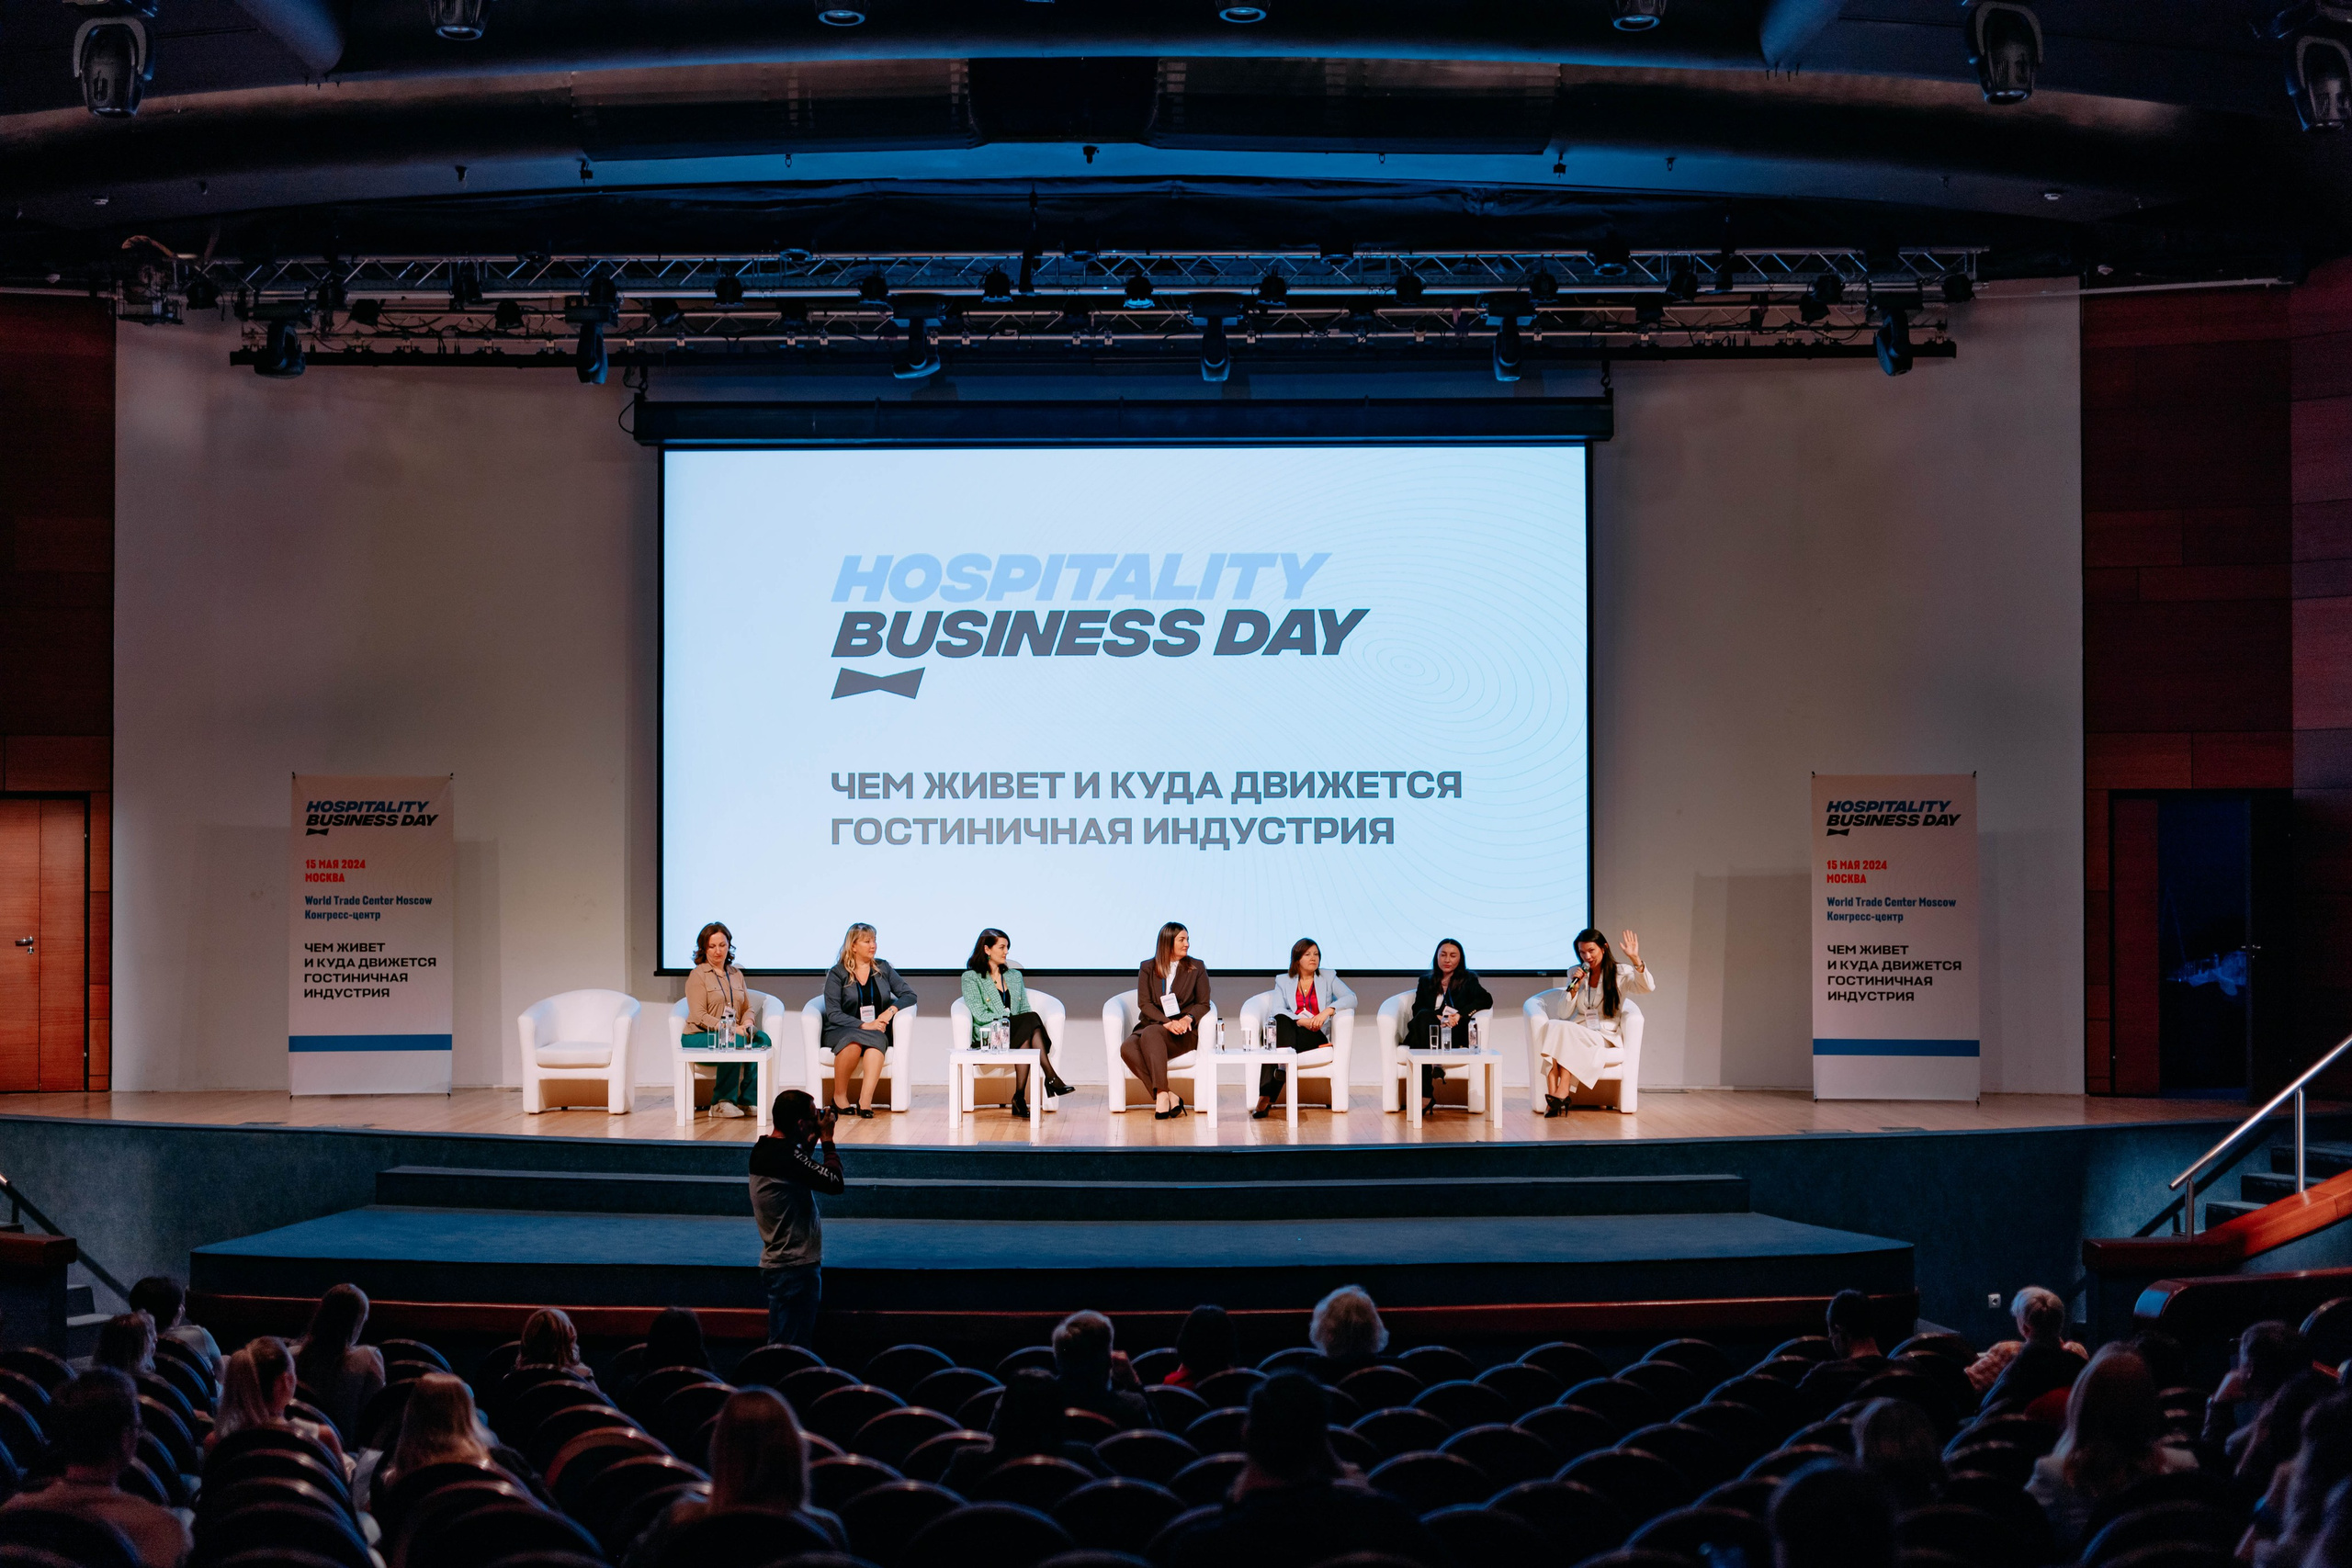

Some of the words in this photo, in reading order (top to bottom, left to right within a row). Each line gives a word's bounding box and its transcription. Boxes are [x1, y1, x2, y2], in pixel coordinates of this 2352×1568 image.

[831, 553, 1332, 603] HOSPITALITY
[831, 609, 1204, 658] BUSINESS
[1214, 609, 1370, 655] DAY
[831, 773, 913, 799] ЧЕМ
[923, 773, 1065, 798] ЖИВЕТ
[1075, 772, 1100, 798] И
[1112, 772, 1223, 805] КУДА
[1231, 771, 1462, 805] ДВИЖЕТСЯ
[306, 801, 429, 813] HOSPITALITY
[1826, 801, 1951, 813] HOSPITALITY
[306, 814, 399, 826] BUSINESS
[401, 815, 438, 826] DAY
[1826, 814, 1920, 826] BUSINESS
[1923, 814, 1962, 826] DAY
[832, 818, 1132, 845] ГОСТИНИЧНАЯ
[1144, 817, 1394, 851] ИНДУСТРИЯ
[305, 859, 317, 870] 15
[318, 859, 340, 869] МАЯ
[341, 859, 367, 870] 2024
[1826, 860, 1838, 870] 15
[1839, 860, 1860, 871] МАЯ
[1862, 859, 1888, 871] 2024
[304, 872, 345, 883] МОСКВА
[1826, 873, 1867, 884] МОСКВА
[304, 895, 332, 906] World
[334, 895, 361, 906] Trade
[362, 895, 394, 906] Center
[395, 895, 433, 906] Moscow
[1826, 897, 1854, 907] World
[1855, 897, 1883, 908] Trade
[1883, 897, 1917, 908] Center
[1918, 897, 1957, 908] Moscow
[304, 909, 381, 922] Конгресс-центр
[1826, 910, 1905, 924] Конгресс-центр
[304, 942, 334, 953] ЧЕМ
[336, 942, 386, 953] ЖИВЕТ
[1826, 944, 1857, 955] ЧЕМ
[1859, 944, 1910, 955] ЖИВЕТ
[304, 957, 314, 968] И
[316, 957, 356, 970] КУДА
[357, 957, 436, 970] ДВИЖЕТСЯ
[1827, 960, 1838, 970] И
[1839, 960, 1880, 973] КУДА
[1881, 960, 1962, 973] ДВИЖЕТСЯ
[304, 972, 409, 984] ГОСТИНИЧНАЯ
[1827, 976, 1933, 987] ГОСТИНИЧНАЯ
[303, 987, 390, 1000] ИНДУСТРИЯ
[1827, 990, 1915, 1003] ИНДУСТРИЯ
